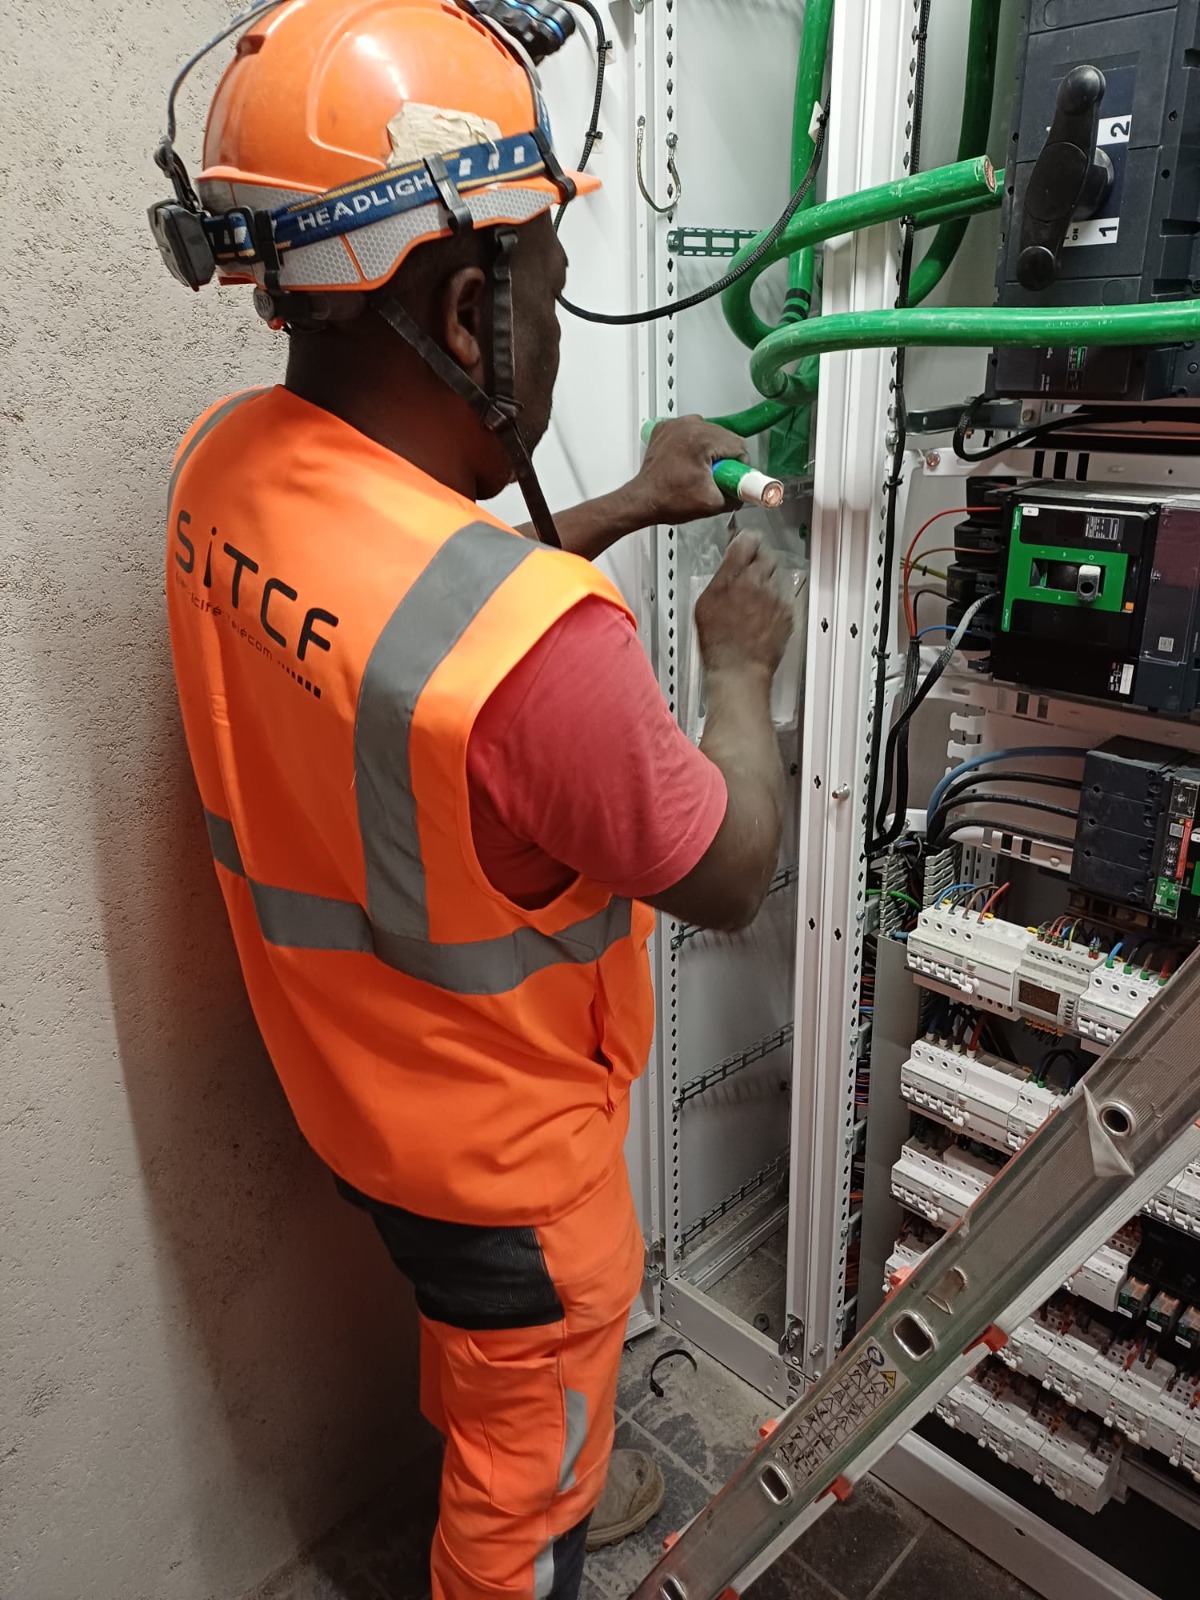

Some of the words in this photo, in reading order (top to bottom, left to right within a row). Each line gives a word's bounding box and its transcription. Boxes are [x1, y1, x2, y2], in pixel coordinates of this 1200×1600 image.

[1110, 120, 1131, 138] 2
[297, 171, 434, 232] HEADLIGH
[1099, 225, 1118, 238] 1
